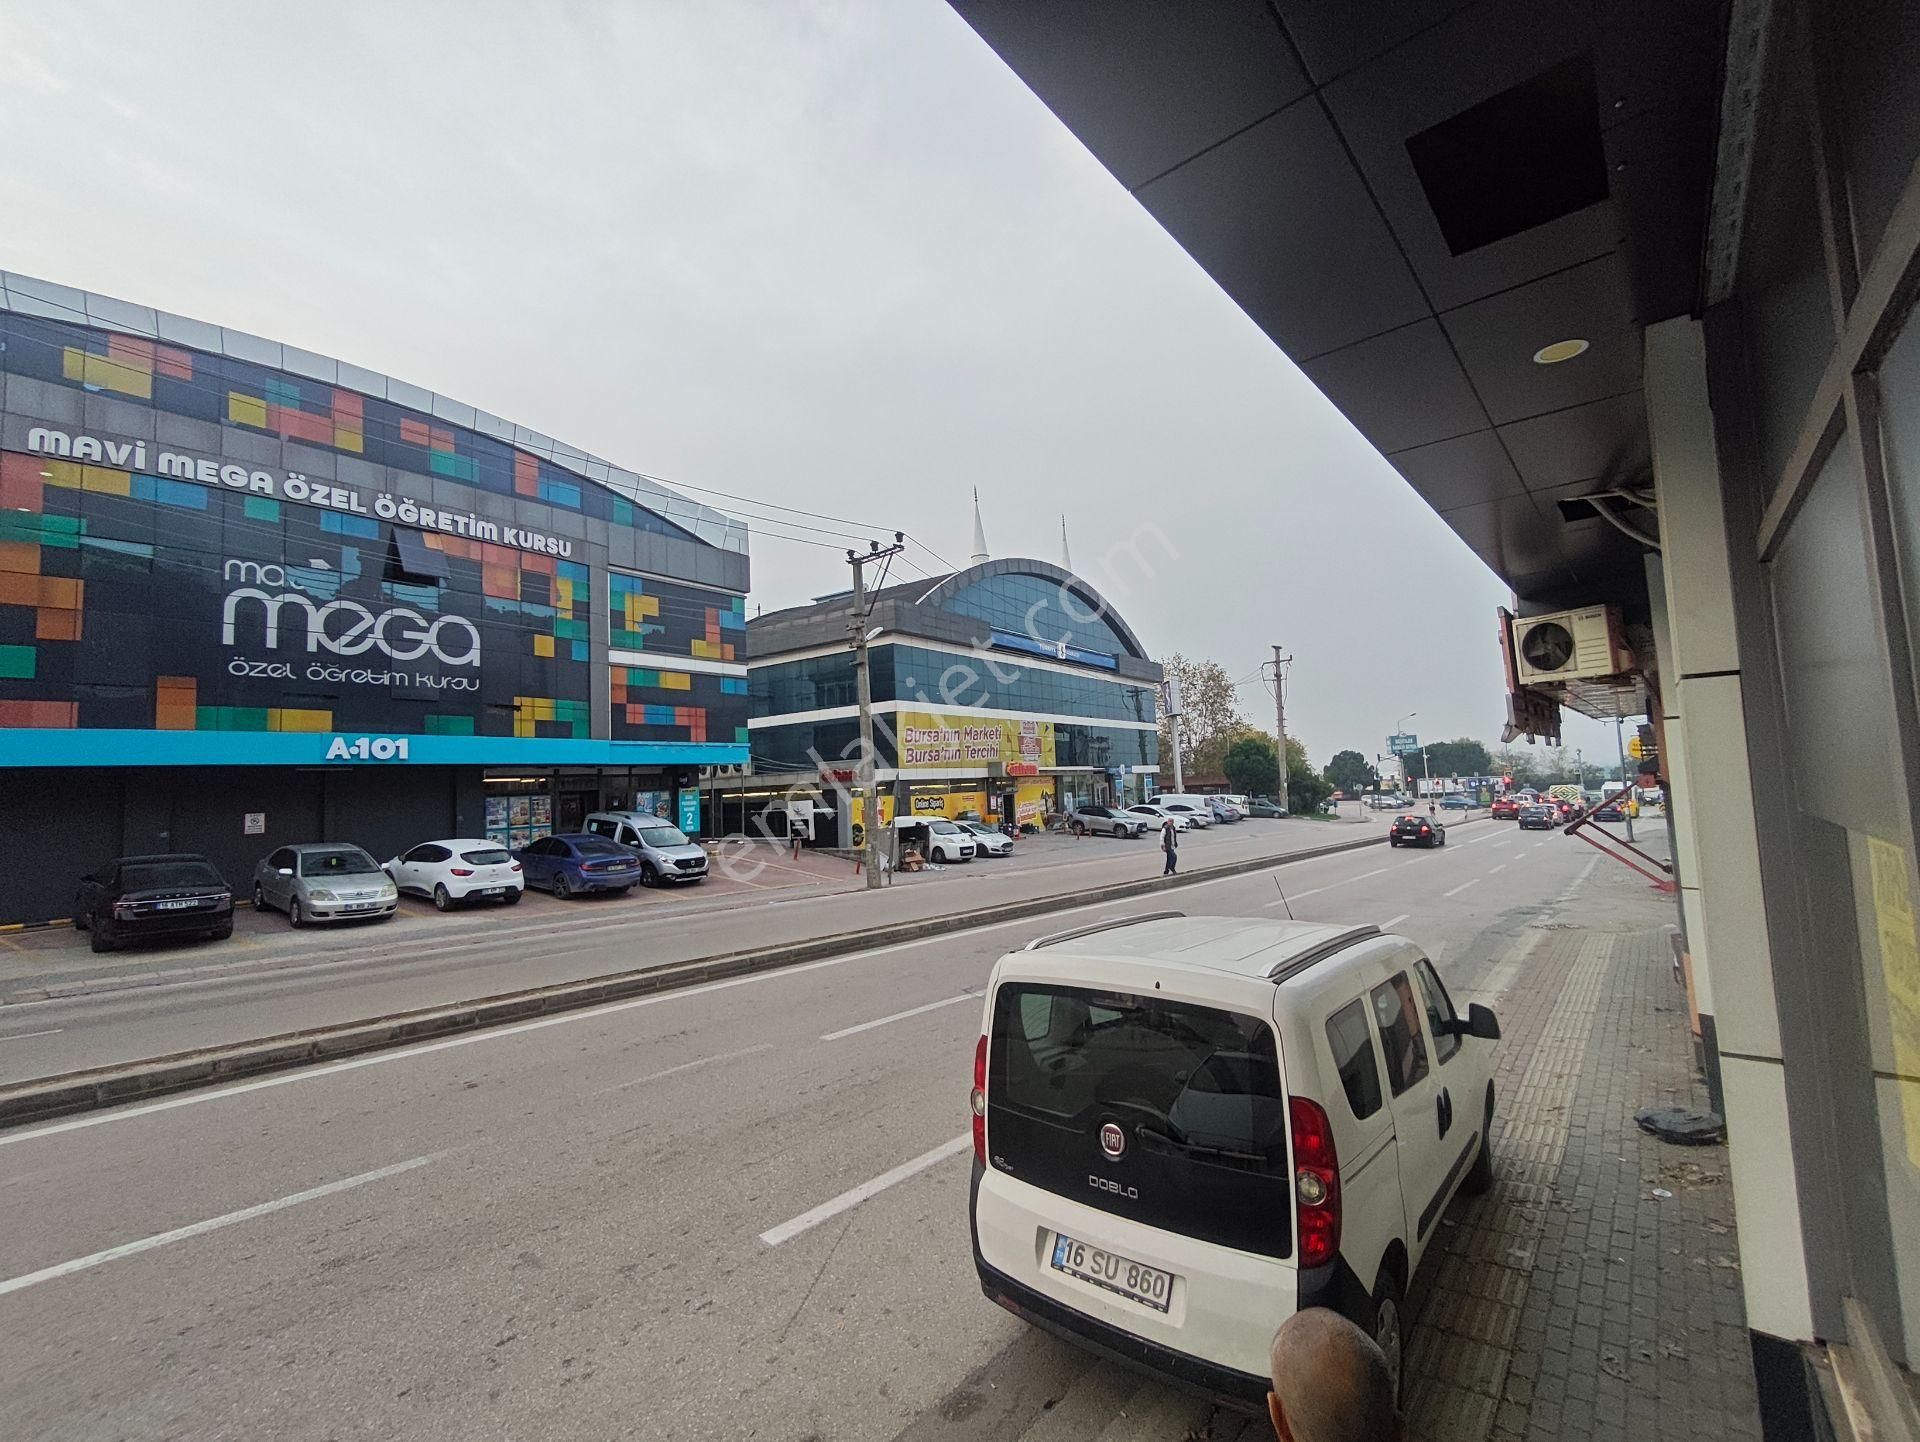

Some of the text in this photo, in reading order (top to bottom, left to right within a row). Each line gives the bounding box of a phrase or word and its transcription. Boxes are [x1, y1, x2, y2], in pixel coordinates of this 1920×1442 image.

[158, 452, 274, 495] MEGA
[283, 472, 367, 514] ÖZEL
[503, 526, 572, 558] KURSU
[963, 725, 1002, 741] Marketi
[964, 744, 999, 760] Tercihi
[686, 812, 694, 825] 2
[1105, 1132, 1120, 1148] FIAT
[1088, 1174, 1139, 1199] DOBLO
[1066, 1241, 1085, 1267] 16
[1090, 1250, 1120, 1280] SU
[1126, 1264, 1165, 1299] 860
